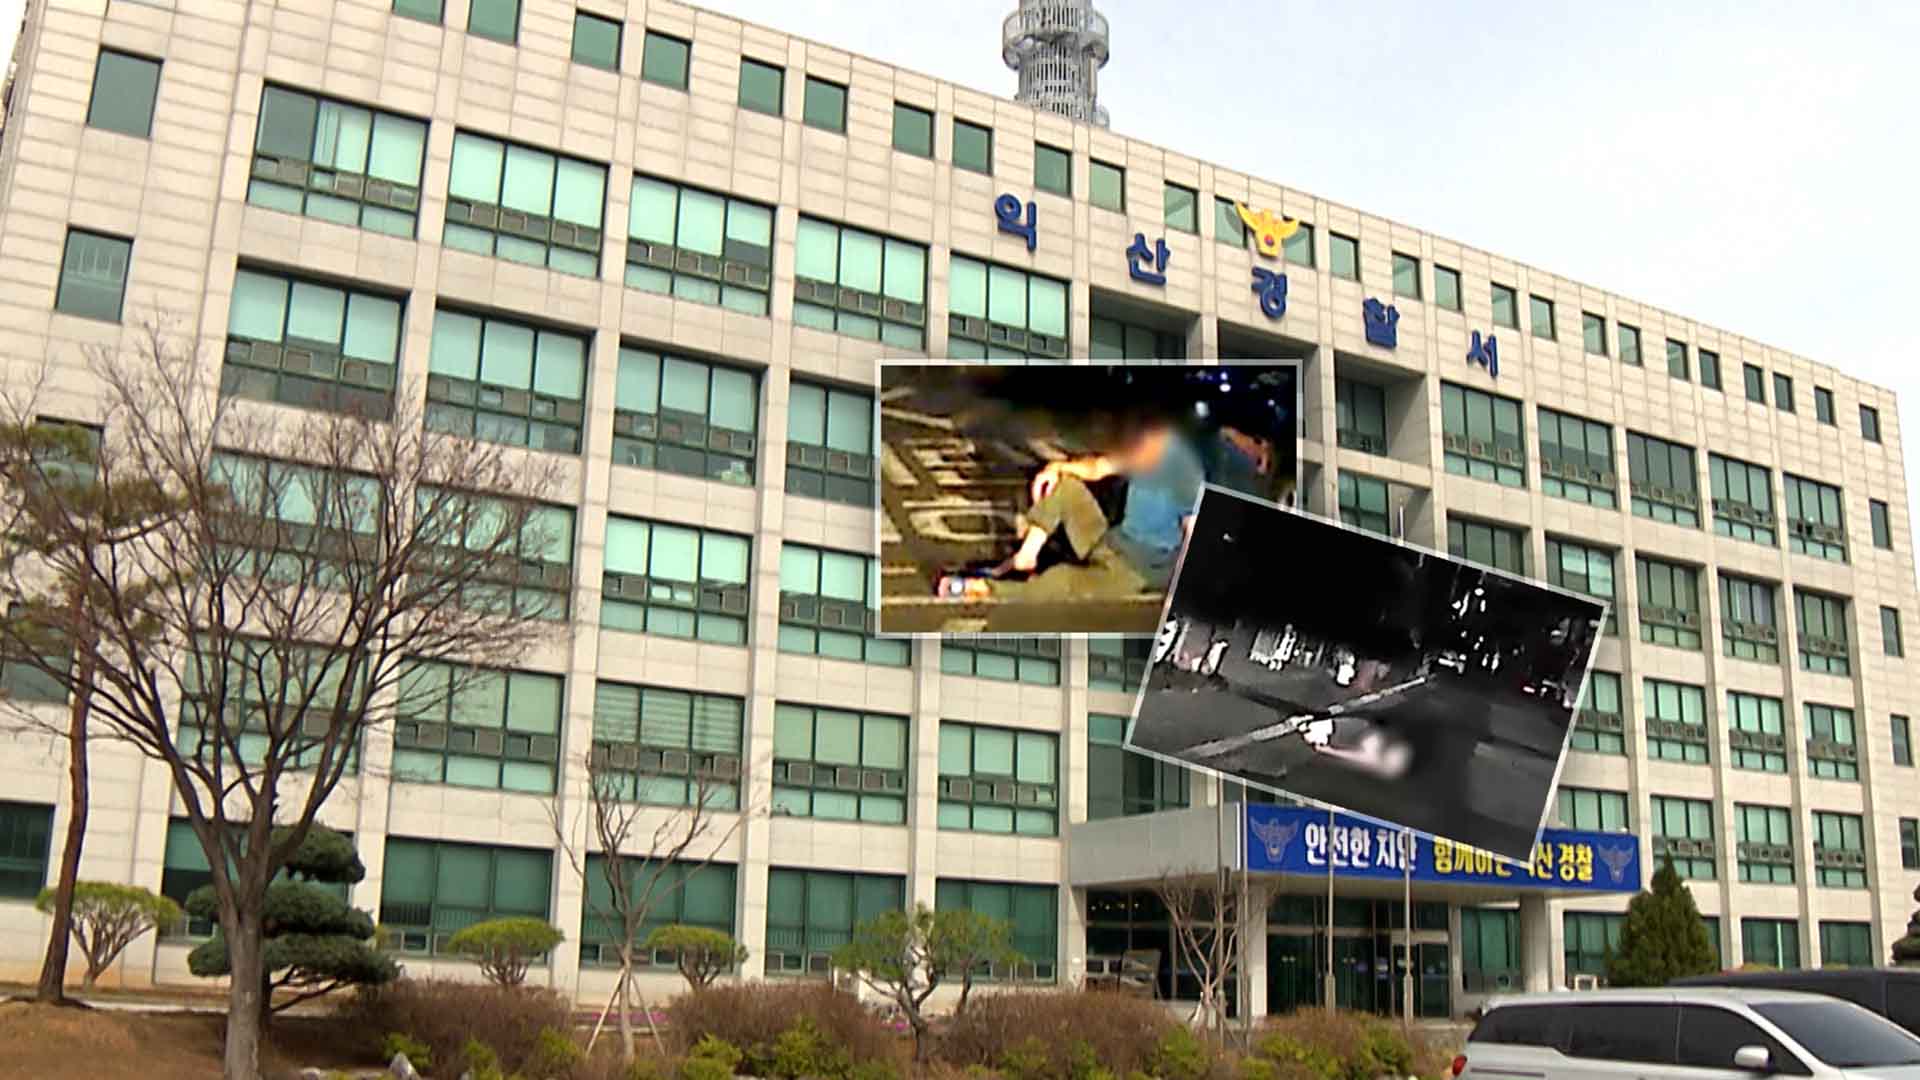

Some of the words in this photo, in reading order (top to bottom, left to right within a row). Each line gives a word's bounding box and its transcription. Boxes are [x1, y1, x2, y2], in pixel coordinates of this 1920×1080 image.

[1305, 823, 1371, 868] 안전한
[1376, 828, 1417, 870] 치안
[1529, 842, 1553, 880] 산
[1558, 843, 1593, 881] 경찰
